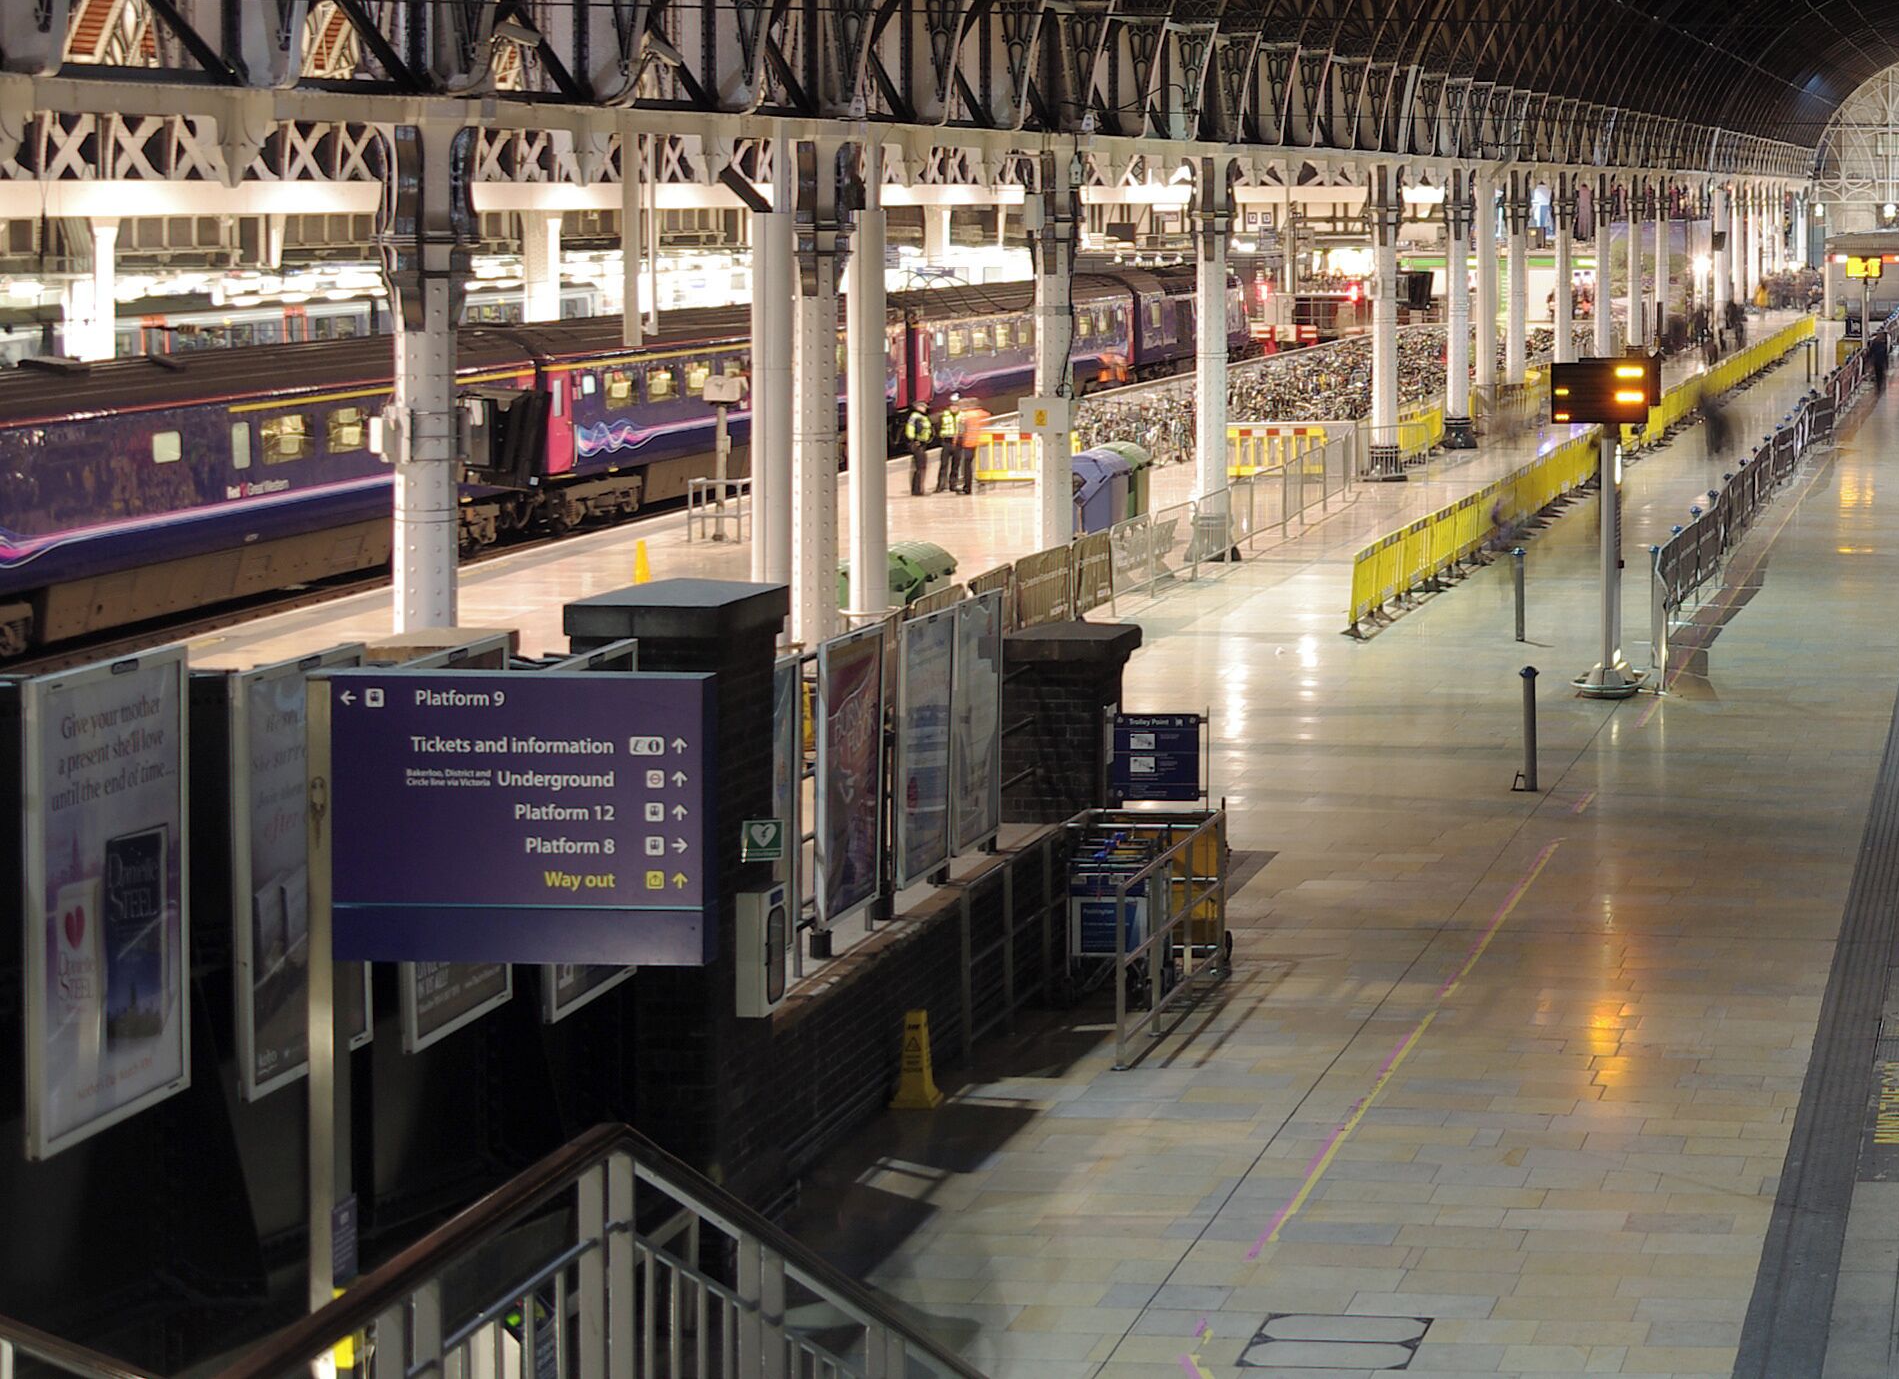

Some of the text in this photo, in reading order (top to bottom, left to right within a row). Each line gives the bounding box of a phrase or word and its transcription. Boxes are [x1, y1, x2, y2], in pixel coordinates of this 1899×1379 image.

[415, 689, 505, 707] Platform 9
[61, 693, 162, 740] Give your mother
[1151, 717, 1170, 726] Point
[58, 757, 65, 775] a
[67, 744, 110, 779] present
[141, 728, 165, 751] love
[410, 734, 614, 754] Tickets and information
[475, 768, 492, 777] and
[497, 770, 615, 792] Underground
[51, 781, 80, 812] until
[81, 777, 101, 803] the
[104, 767, 126, 796] end
[127, 762, 139, 789] of
[515, 803, 615, 821] Platform 12
[525, 837, 616, 855] Platform 8
[544, 871, 616, 892] Way out
[109, 886, 158, 922] STEEL
